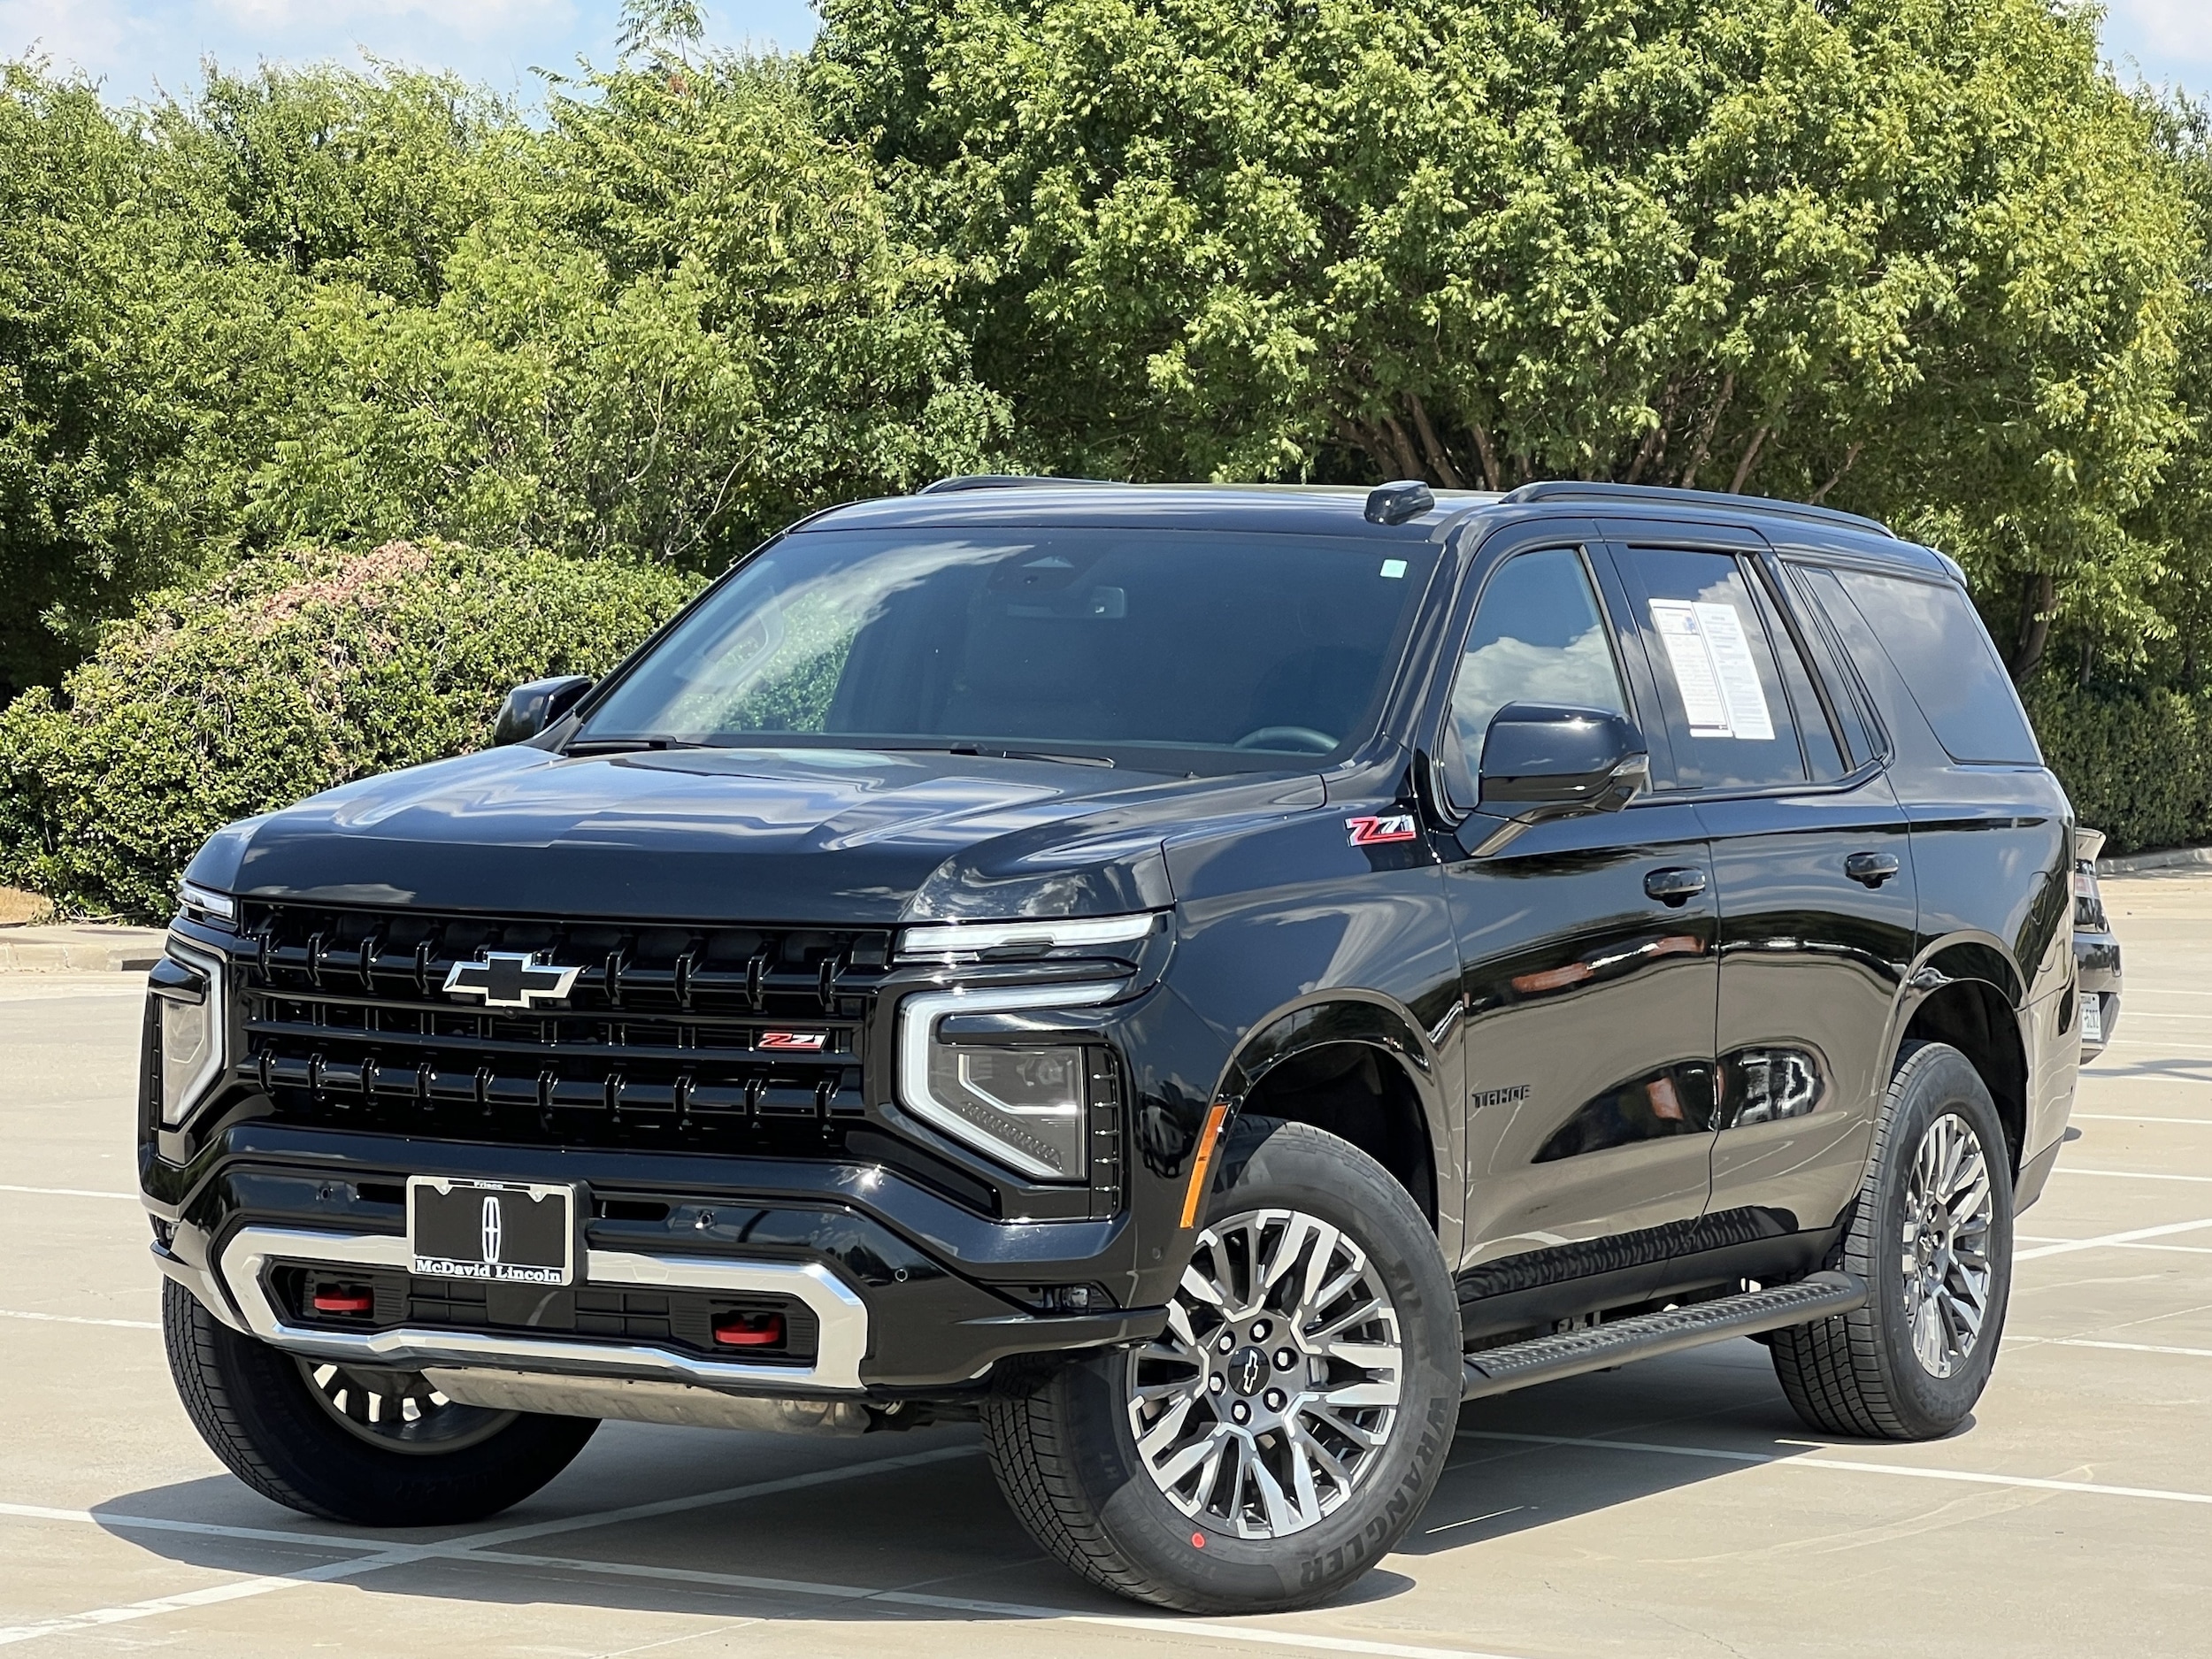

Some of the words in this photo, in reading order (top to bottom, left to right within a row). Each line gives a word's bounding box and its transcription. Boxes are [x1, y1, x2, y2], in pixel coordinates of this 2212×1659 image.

[1345, 815, 1416, 847] Z71
[757, 1033, 826, 1048] Z71
[1471, 1085, 1531, 1109] TAHOE
[416, 1259, 490, 1278] McDavid
[495, 1265, 562, 1283] Lincoln
[1300, 1397, 1449, 1588] WRANGLER
